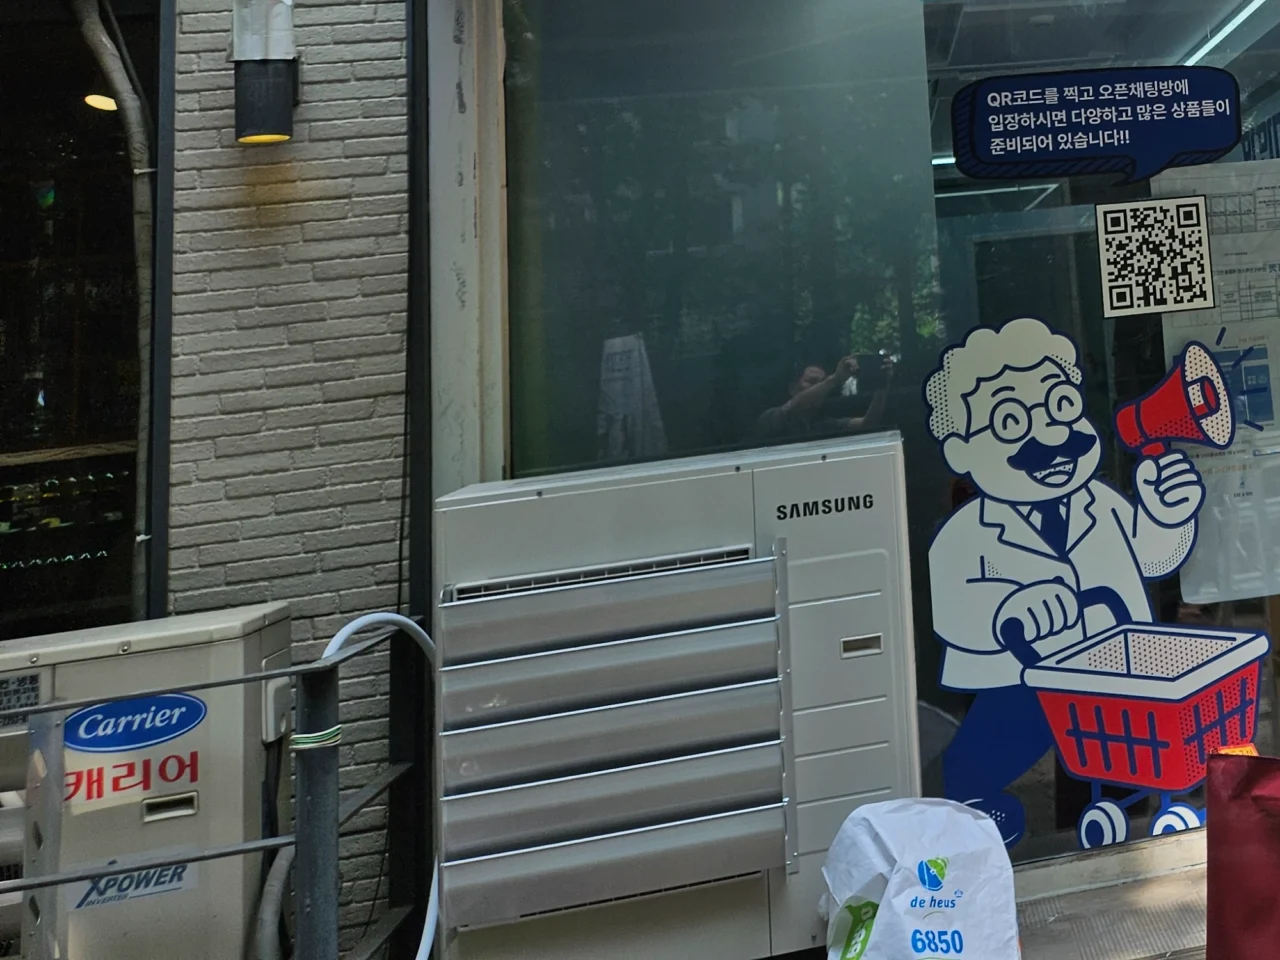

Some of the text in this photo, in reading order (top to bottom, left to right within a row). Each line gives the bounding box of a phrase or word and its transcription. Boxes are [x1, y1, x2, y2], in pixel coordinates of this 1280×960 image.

[987, 79, 1189, 107] QR코드를 찍고 오픈채팅방에
[988, 99, 1230, 132] 입장하시면 다양하고 많은 상품들이
[990, 130, 1130, 155] 준비되어 있습니다!!
[776, 494, 874, 521] SAMSUNG
[77, 704, 187, 739] Carrier
[64, 750, 199, 801] 캐리어
[910, 896, 956, 909] de heus
[911, 929, 964, 954] 6850
